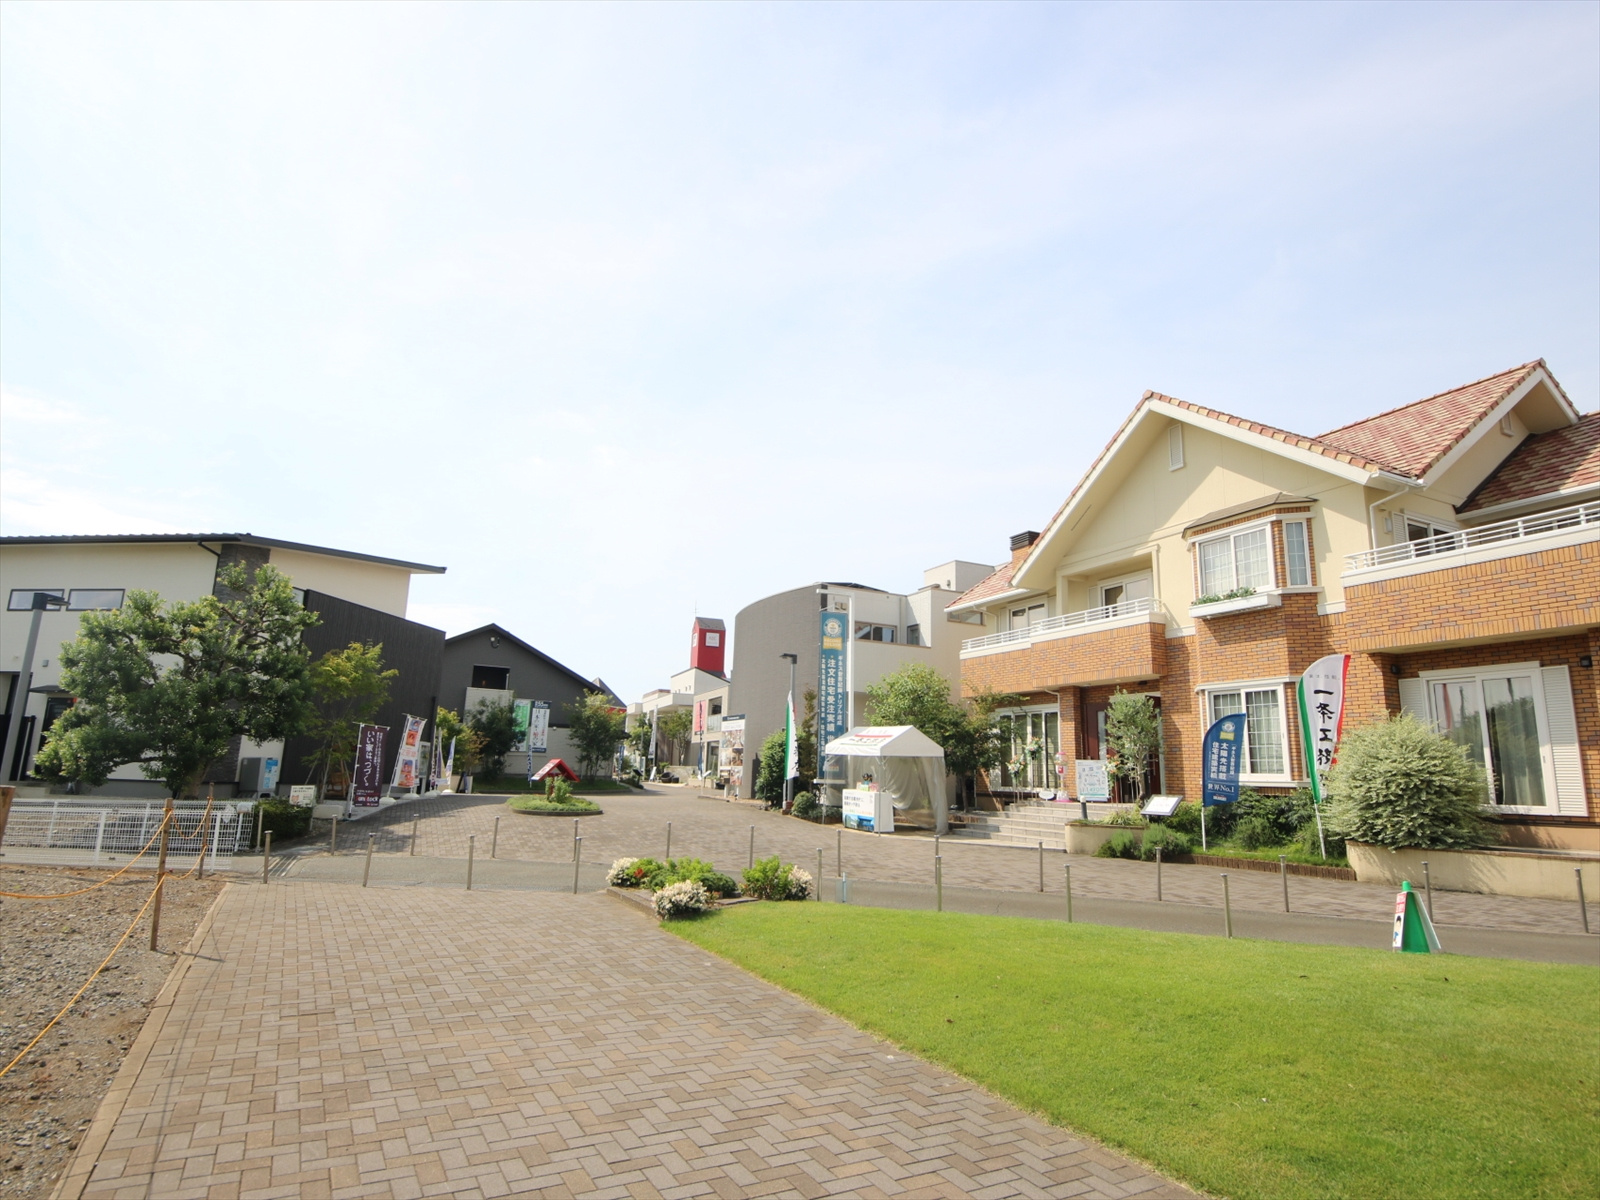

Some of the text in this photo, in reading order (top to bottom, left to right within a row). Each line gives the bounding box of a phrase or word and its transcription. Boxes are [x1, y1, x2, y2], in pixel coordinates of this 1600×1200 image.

[827, 658, 837, 732] 注文住宅受注実績
[363, 730, 376, 787] いい家は、つづく。
[1218, 742, 1229, 781] 太陽光搭載
[1313, 688, 1336, 788] 一条工務
[1207, 783, 1235, 793] 世界No.1
